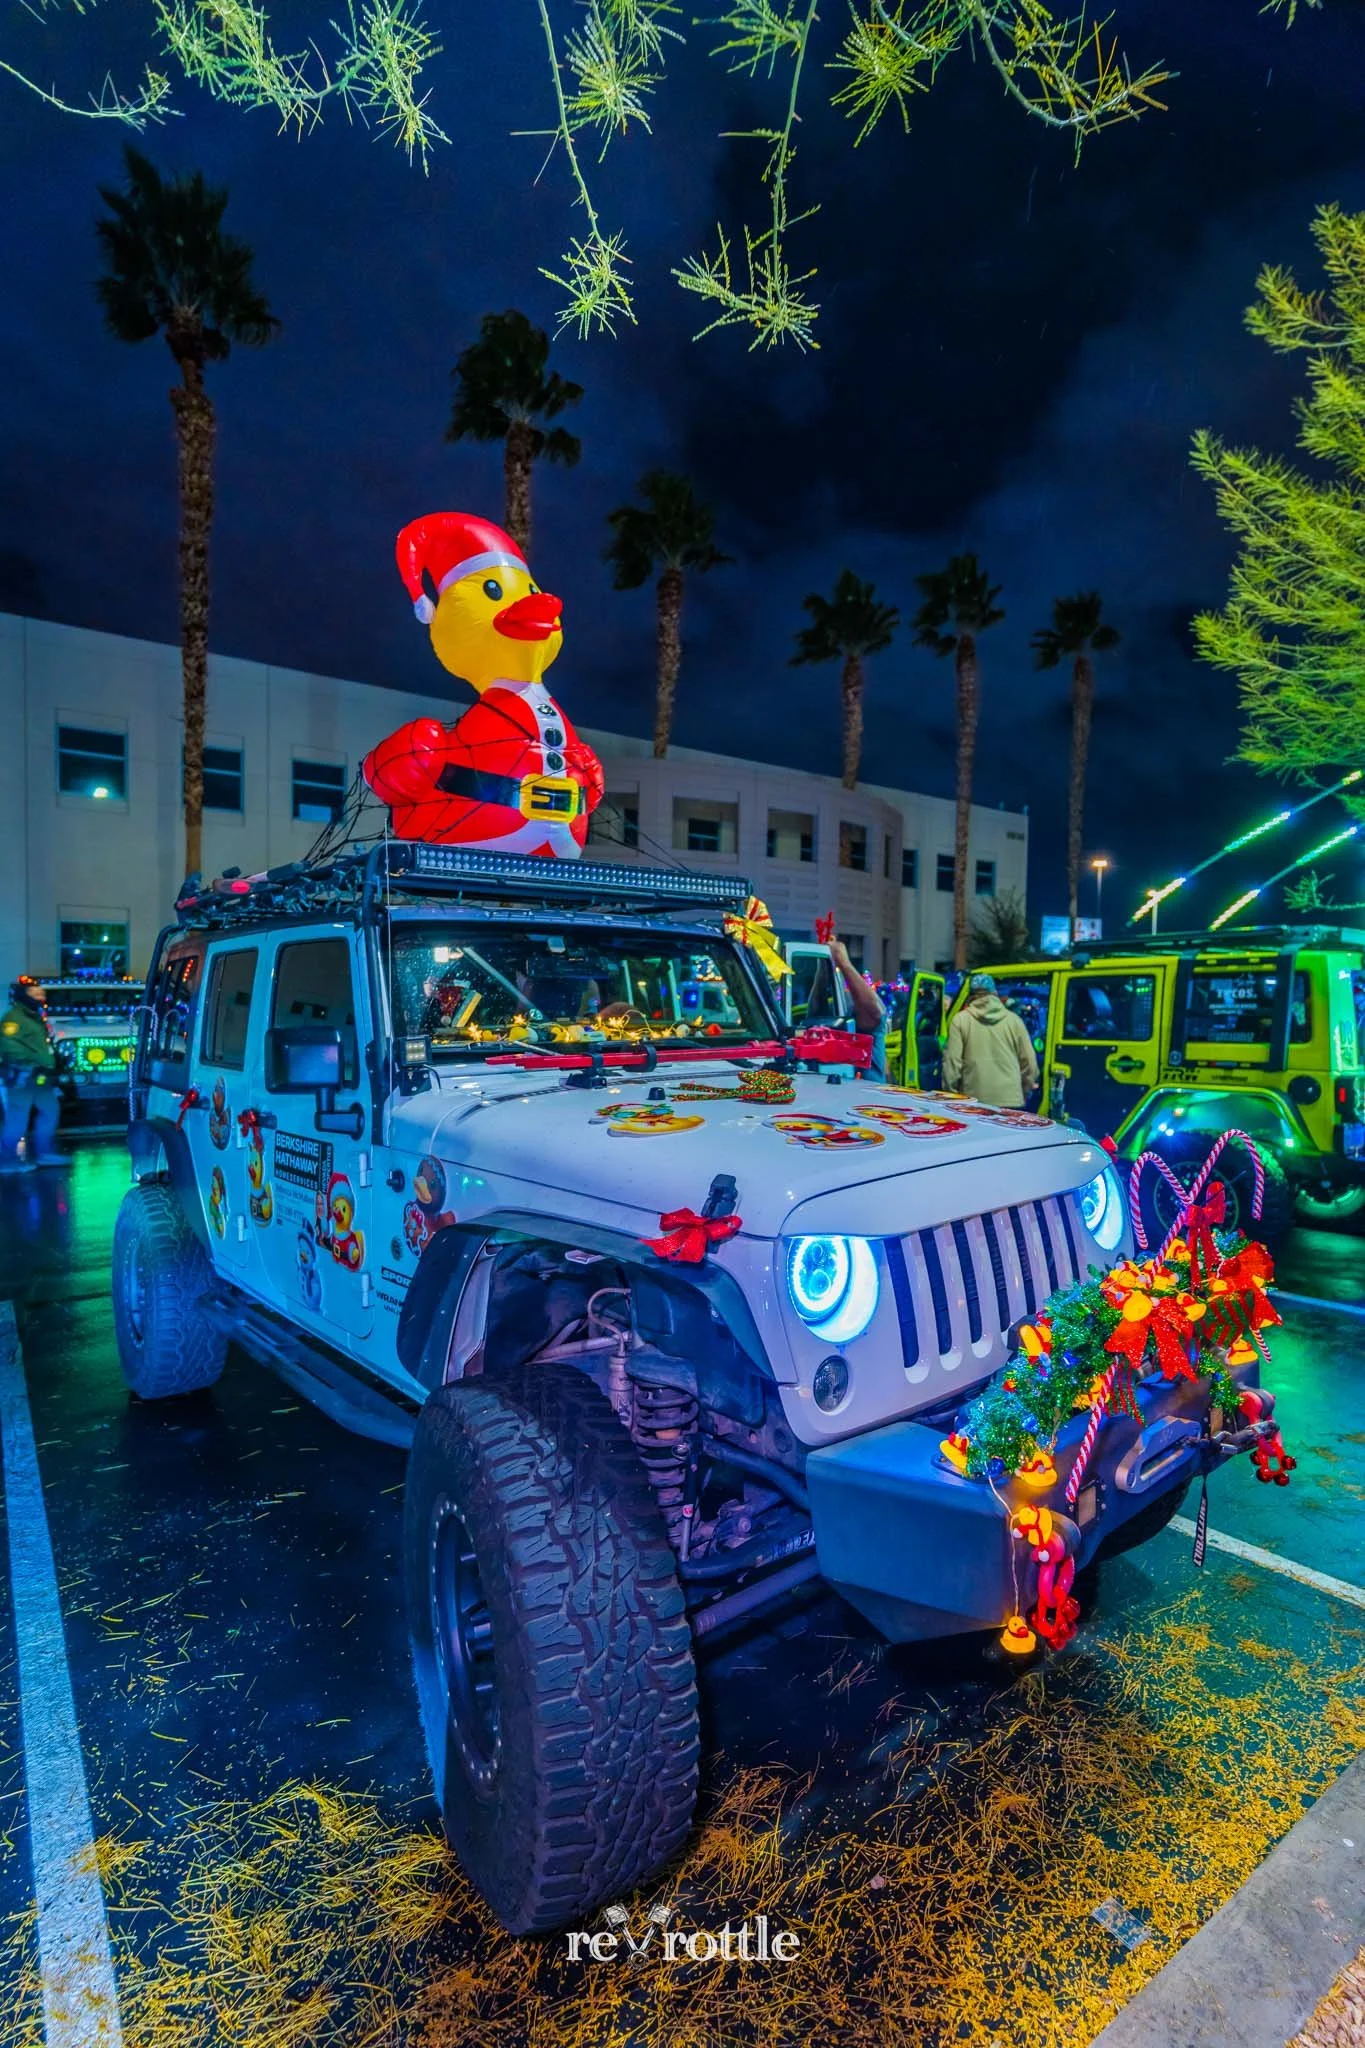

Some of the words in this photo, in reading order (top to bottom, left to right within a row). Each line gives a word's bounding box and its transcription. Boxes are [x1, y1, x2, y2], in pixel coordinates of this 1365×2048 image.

[275, 1132, 320, 1158] BERKSHIRE
[275, 1149, 319, 1177] HATHAWAY
[274, 1167, 318, 1190] HOMESERVICES
[382, 1269, 412, 1288] SPOR
[1193, 1496, 1206, 1567] SMITTYBILT
